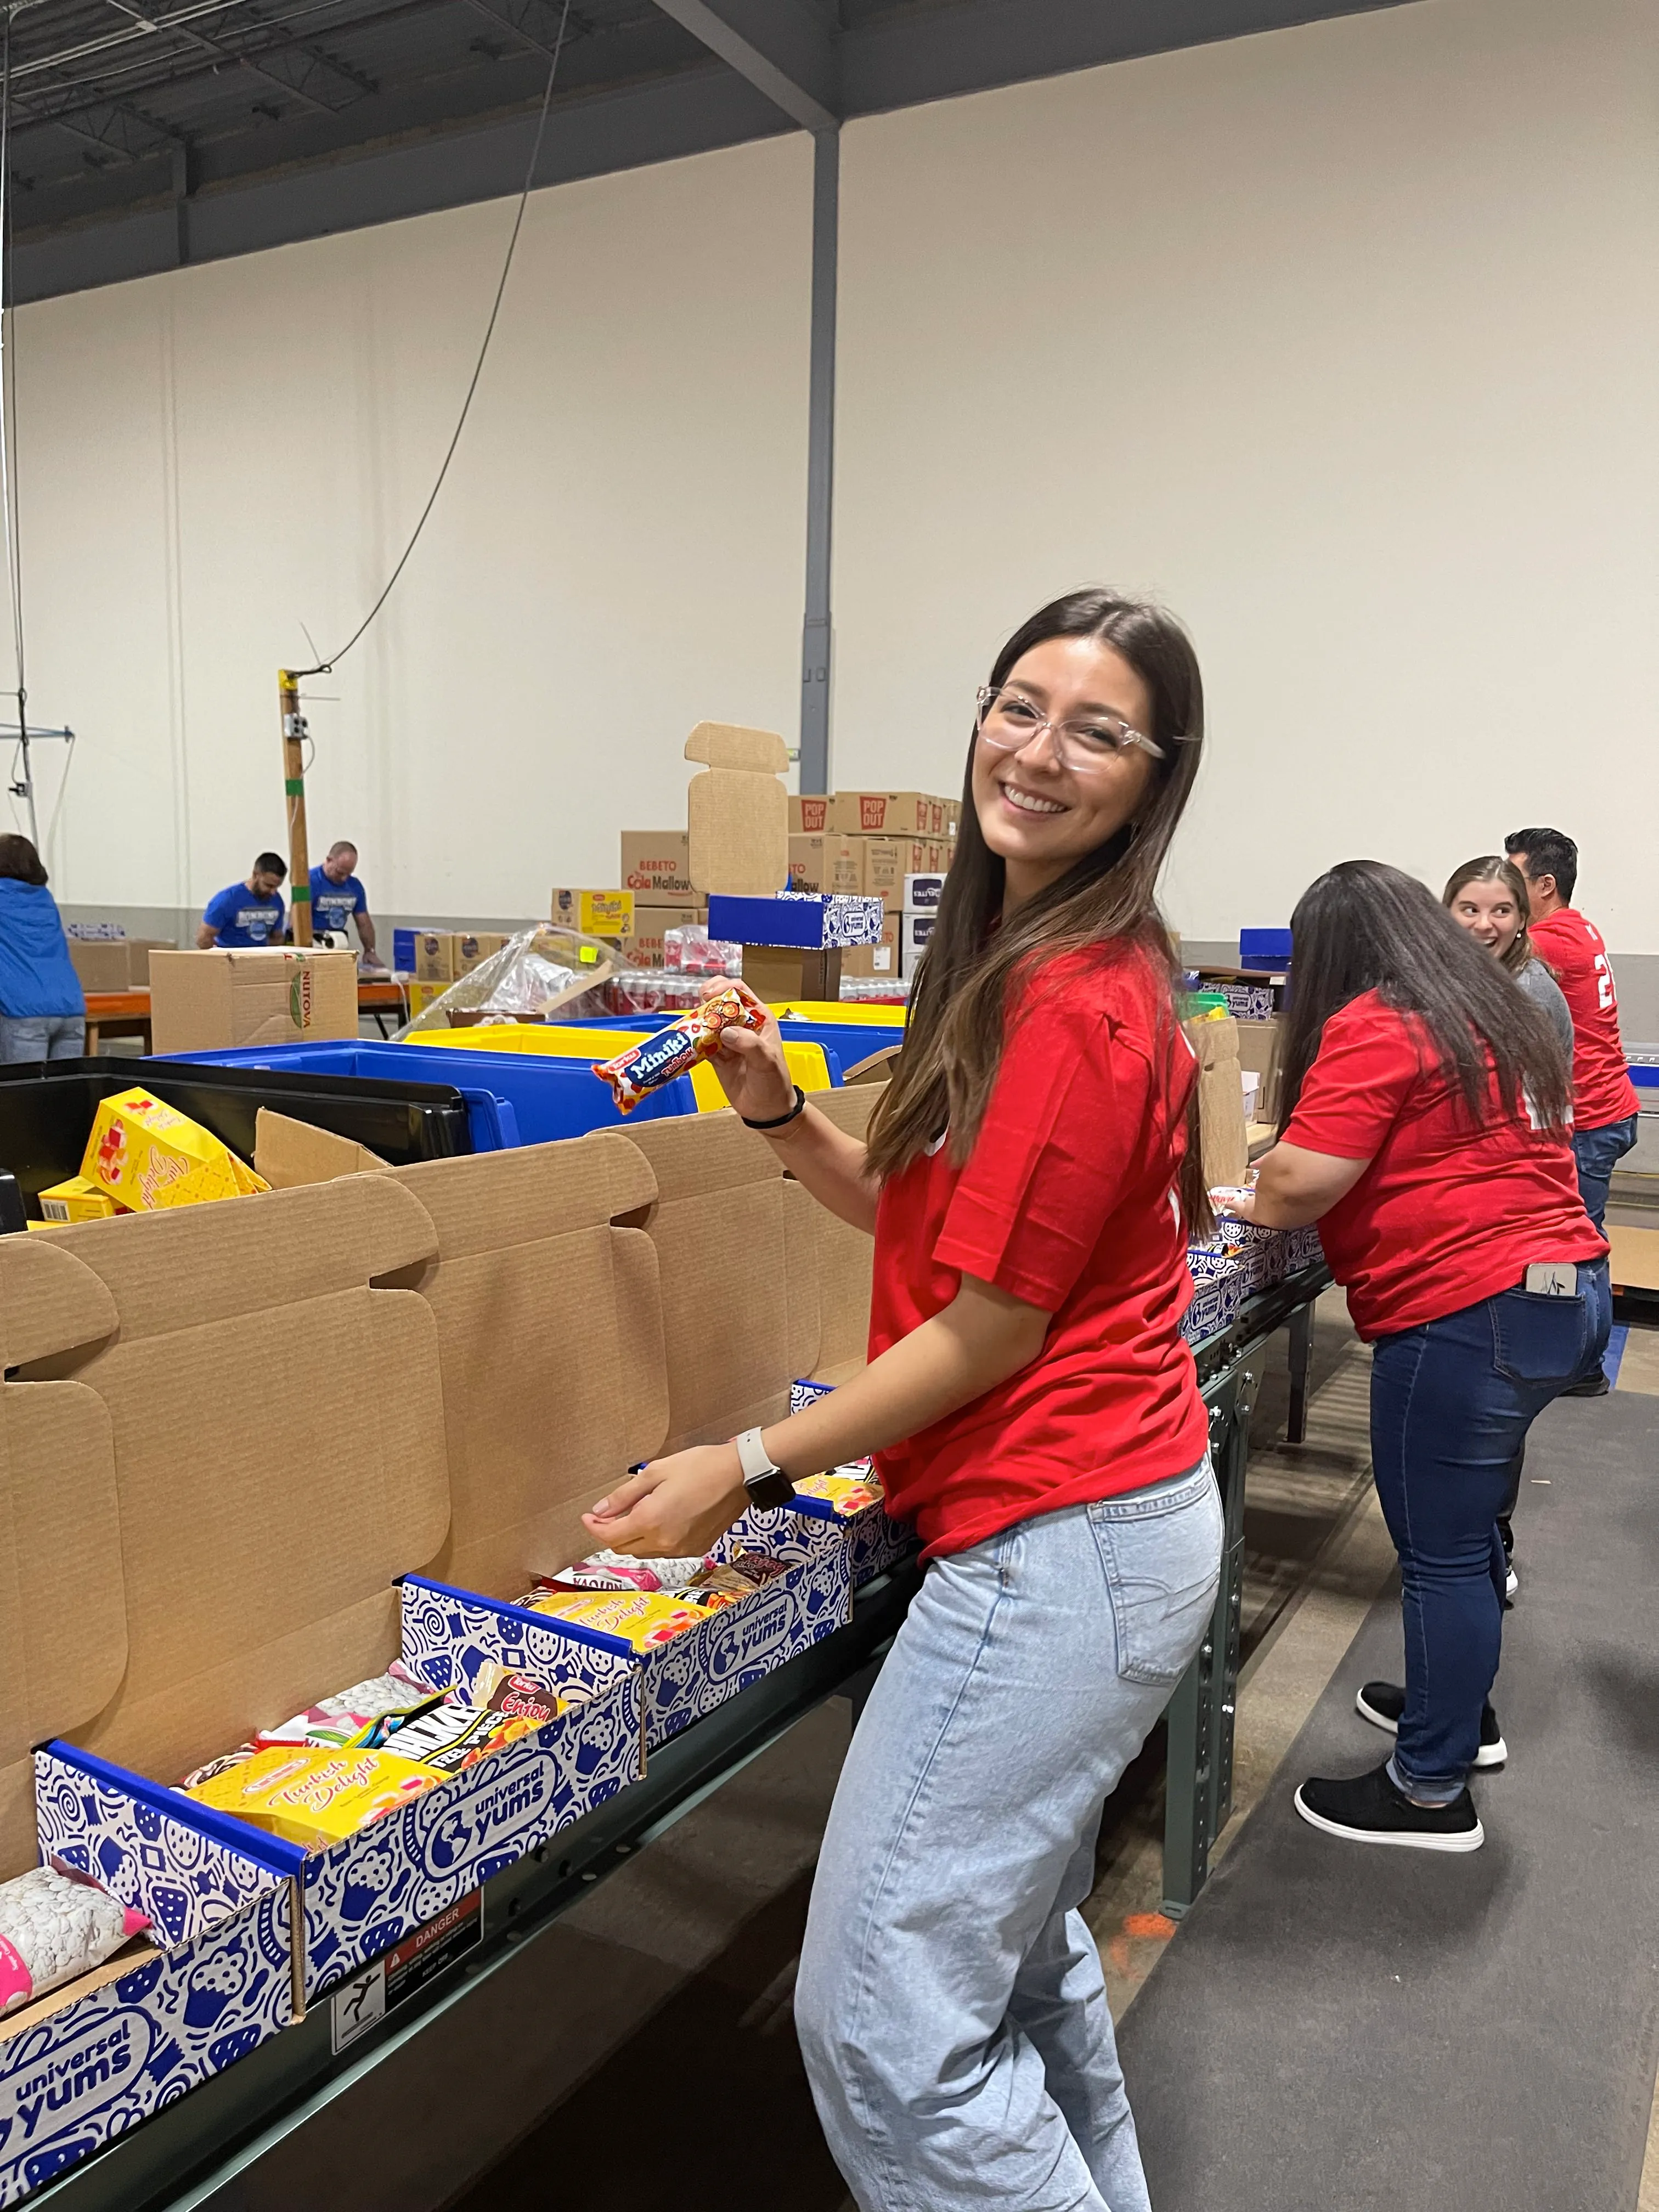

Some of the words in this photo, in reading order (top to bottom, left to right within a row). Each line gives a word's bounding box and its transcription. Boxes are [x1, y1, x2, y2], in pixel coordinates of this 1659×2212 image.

[804, 816, 823, 828] OUT
[805, 803, 824, 816] POP
[863, 800, 884, 813] POP
[863, 813, 883, 826] OUT
[627, 874, 651, 890] Cola
[652, 875, 691, 890] Mallow
[639, 860, 677, 871] BEBETO
[791, 878, 819, 892] allow
[639, 938, 663, 949] BEBE
[302, 971, 311, 1028] NUTOVA
[630, 1032, 689, 1079] Miniki
[597, 1596, 651, 1632] Delight
[742, 1598, 787, 1637] universal
[741, 1614, 786, 1661] yums
[513, 1676, 537, 1691] Torku
[500, 1691, 551, 1722] Enjoy
[268, 1760, 347, 1807] Turkish
[303, 1753, 380, 1812] Delight
[475, 1760, 544, 1815] universal
[475, 1780, 544, 1846] yums
[415, 1908, 460, 1948] DANGER
[15, 2019, 131, 2102] universal
[15, 2043, 131, 2140] yums
